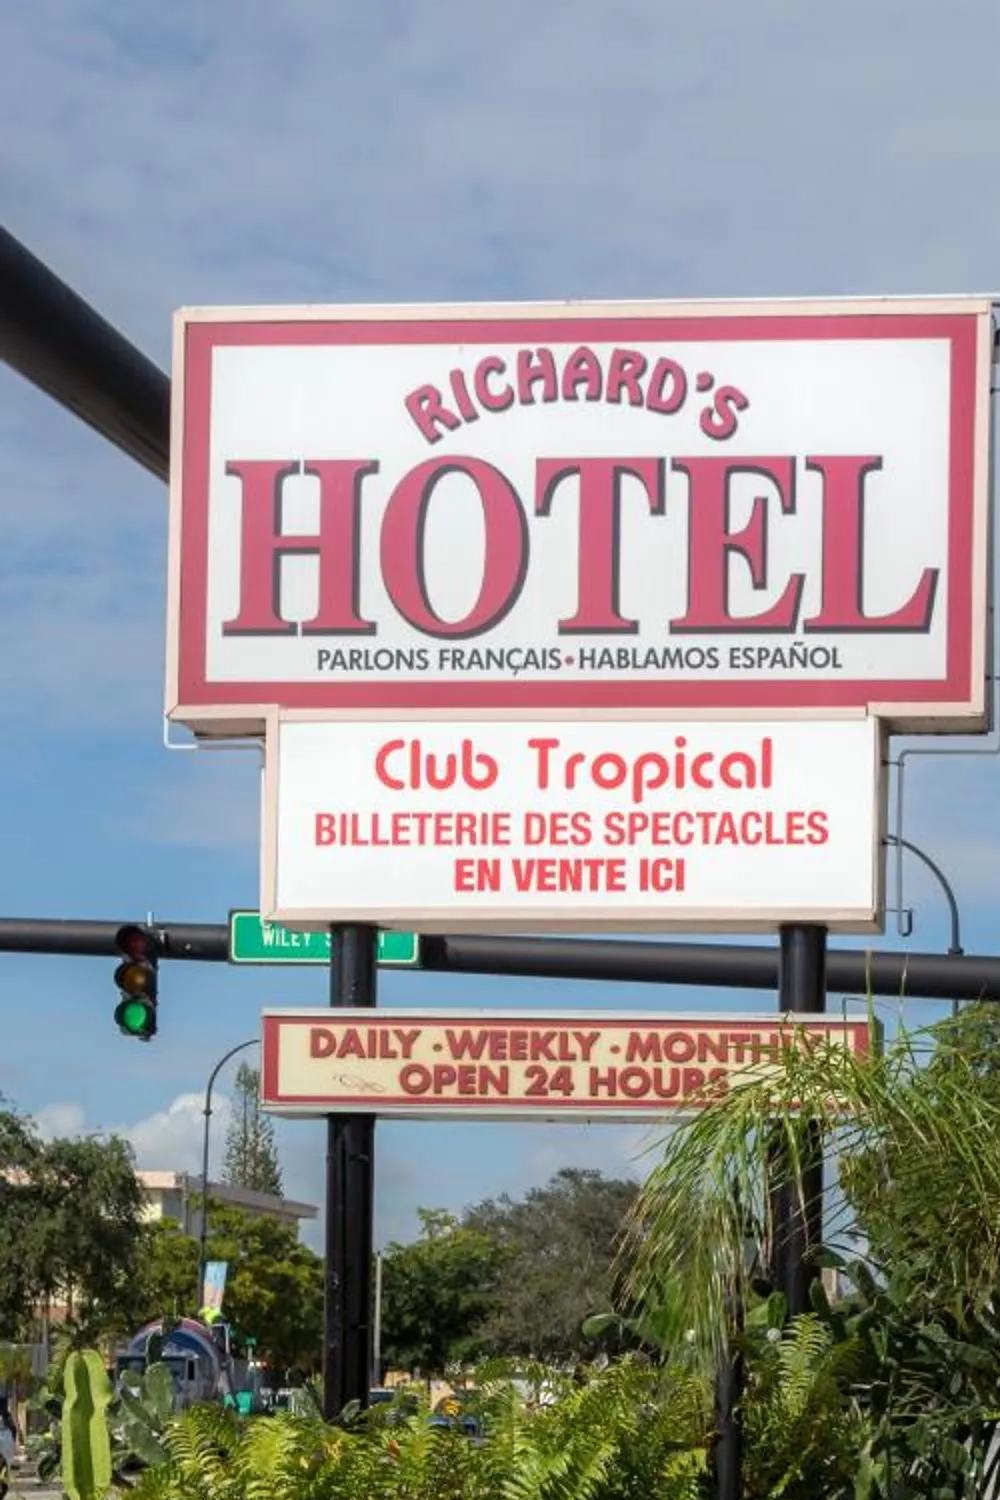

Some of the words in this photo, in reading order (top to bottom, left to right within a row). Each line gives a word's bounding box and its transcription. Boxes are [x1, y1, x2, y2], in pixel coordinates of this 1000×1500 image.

[404, 345, 750, 445] RICHARD'S
[221, 453, 941, 641] HOTEL
[317, 647, 430, 672] PARLONS
[438, 646, 562, 676] FRANÇAIS
[578, 645, 720, 671] HABLAMOS
[729, 641, 843, 670] ESPAÑOL
[374, 738, 499, 791] Club
[527, 736, 773, 804] Tropical
[315, 812, 512, 847] BILLETERIE
[523, 811, 593, 846] DES
[603, 810, 829, 846] SPECTACLES
[454, 858, 501, 892] EN
[511, 858, 627, 892] VENTE
[639, 857, 686, 892] ICI
[262, 928, 312, 947] WILEY
[309, 1028, 422, 1060] DAILY
[445, 1029, 600, 1062] WEEKLY
[398, 1063, 511, 1096] OPEN
[523, 1065, 576, 1097] 24
